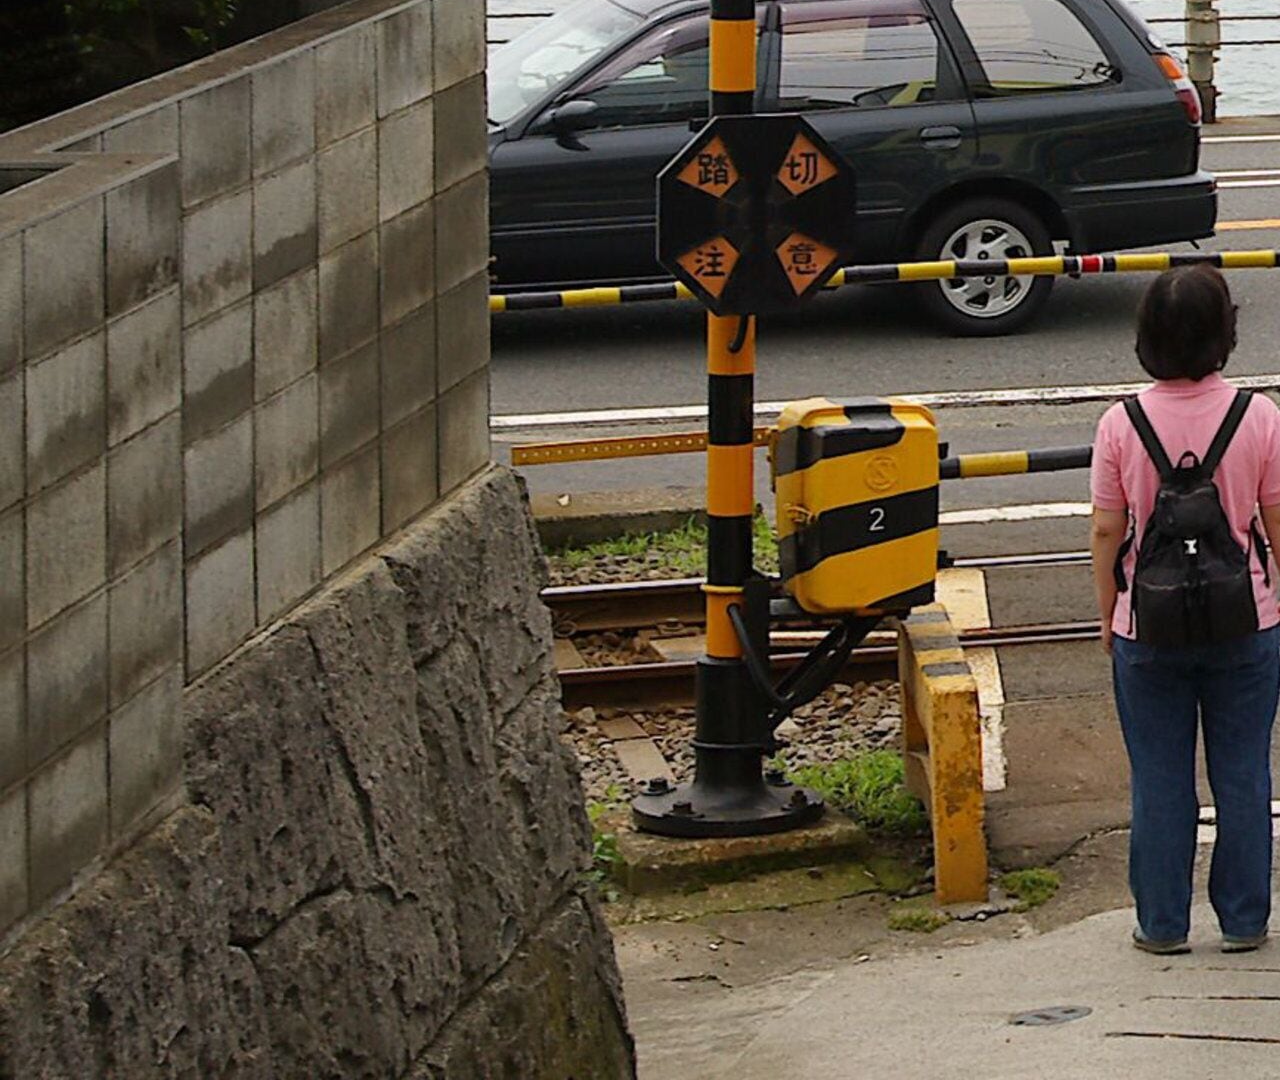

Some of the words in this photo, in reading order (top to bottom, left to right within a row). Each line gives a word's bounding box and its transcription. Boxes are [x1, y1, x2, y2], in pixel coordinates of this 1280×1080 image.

[697, 152, 819, 186] 踏切
[693, 243, 817, 278] 注意
[868, 507, 885, 531] 2
